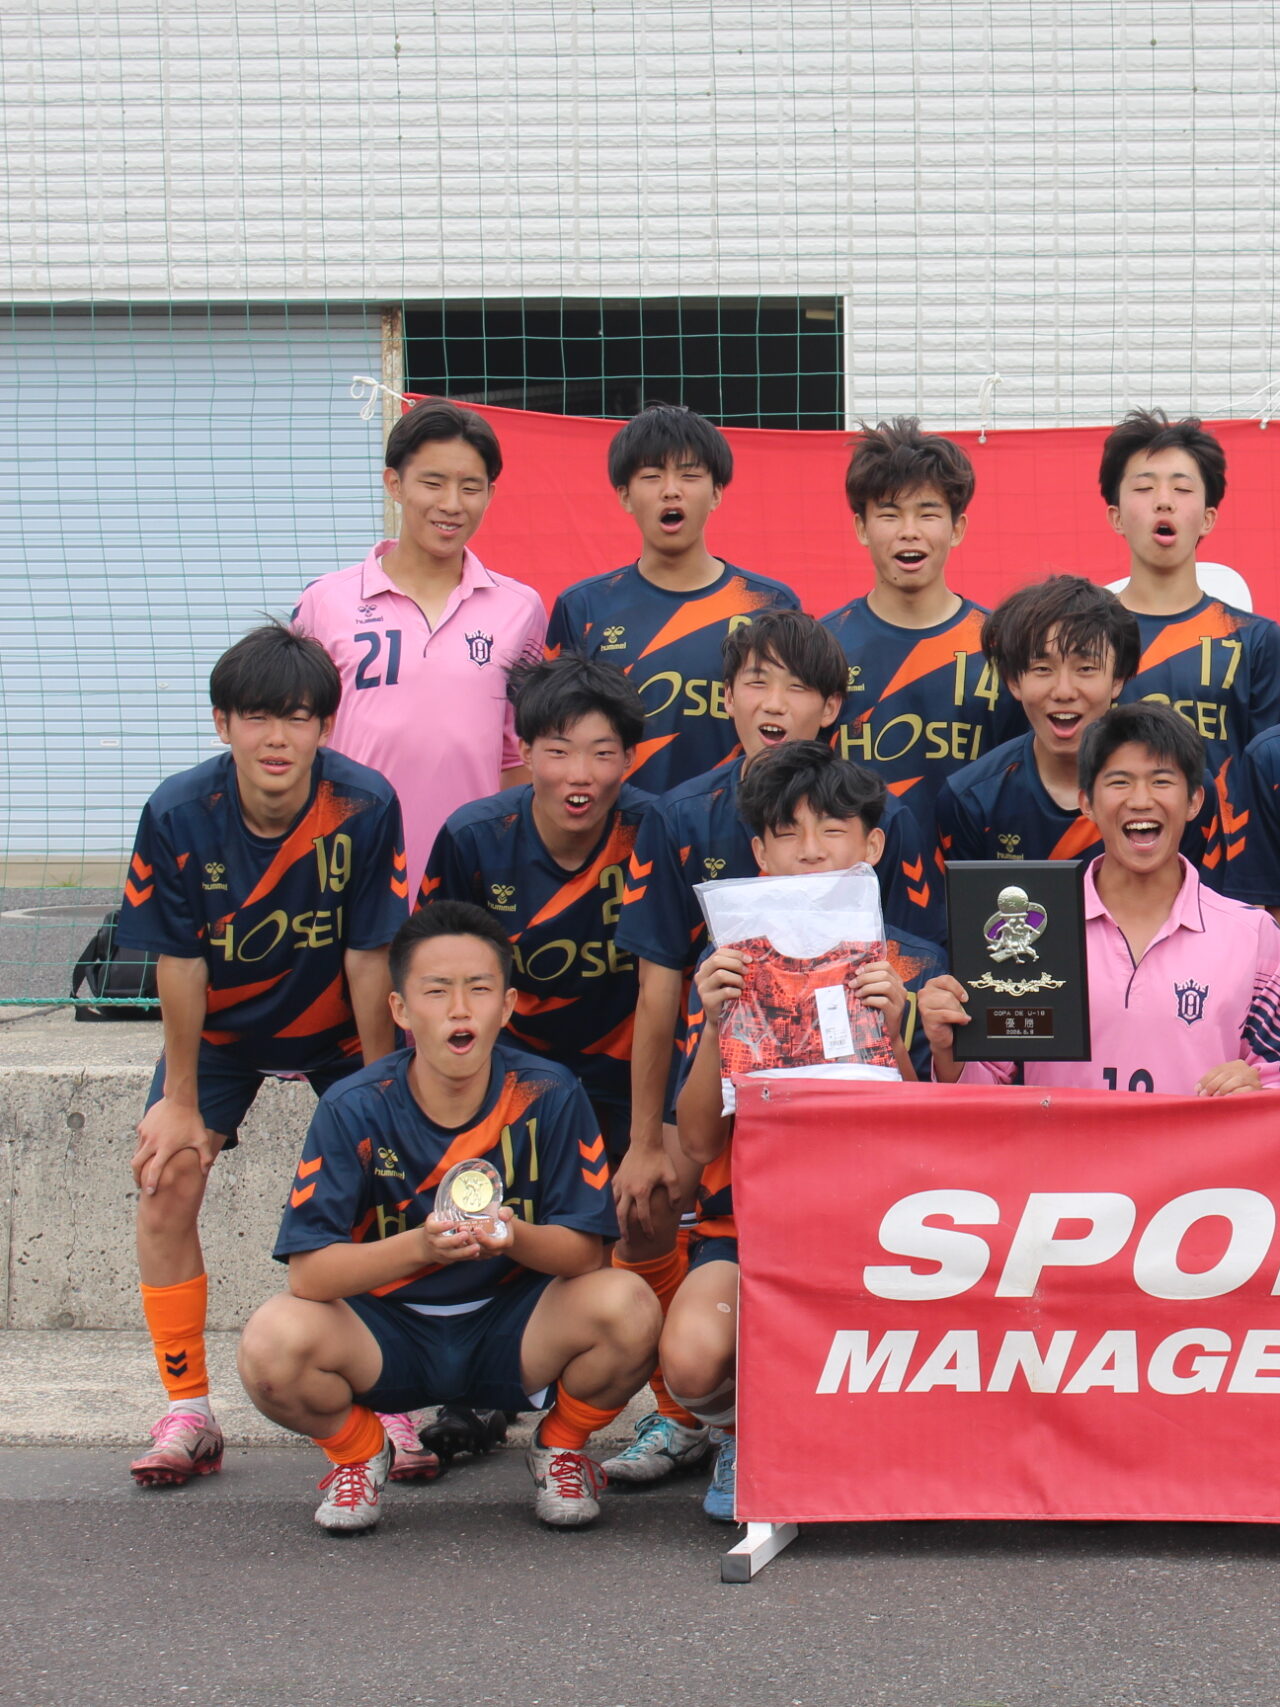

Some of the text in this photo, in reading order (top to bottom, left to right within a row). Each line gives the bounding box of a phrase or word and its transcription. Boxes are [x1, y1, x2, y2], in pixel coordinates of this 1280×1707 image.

[354, 629, 402, 690] 21
[600, 641, 627, 652] hummel
[1199, 636, 1243, 689] 17
[638, 671, 730, 720] OSE
[954, 651, 1000, 712] 14
[840, 713, 983, 762] HOSEI
[1111, 693, 1228, 741] SEI
[202, 882, 229, 892] hummel
[312, 833, 352, 893] 19
[488, 901, 517, 912] hummel
[600, 864, 624, 925] 2
[207, 905, 343, 962] HOSEI
[512, 939, 634, 981] OSE
[374, 1167, 406, 1180] hummel
[501, 1118, 538, 1189] 11
